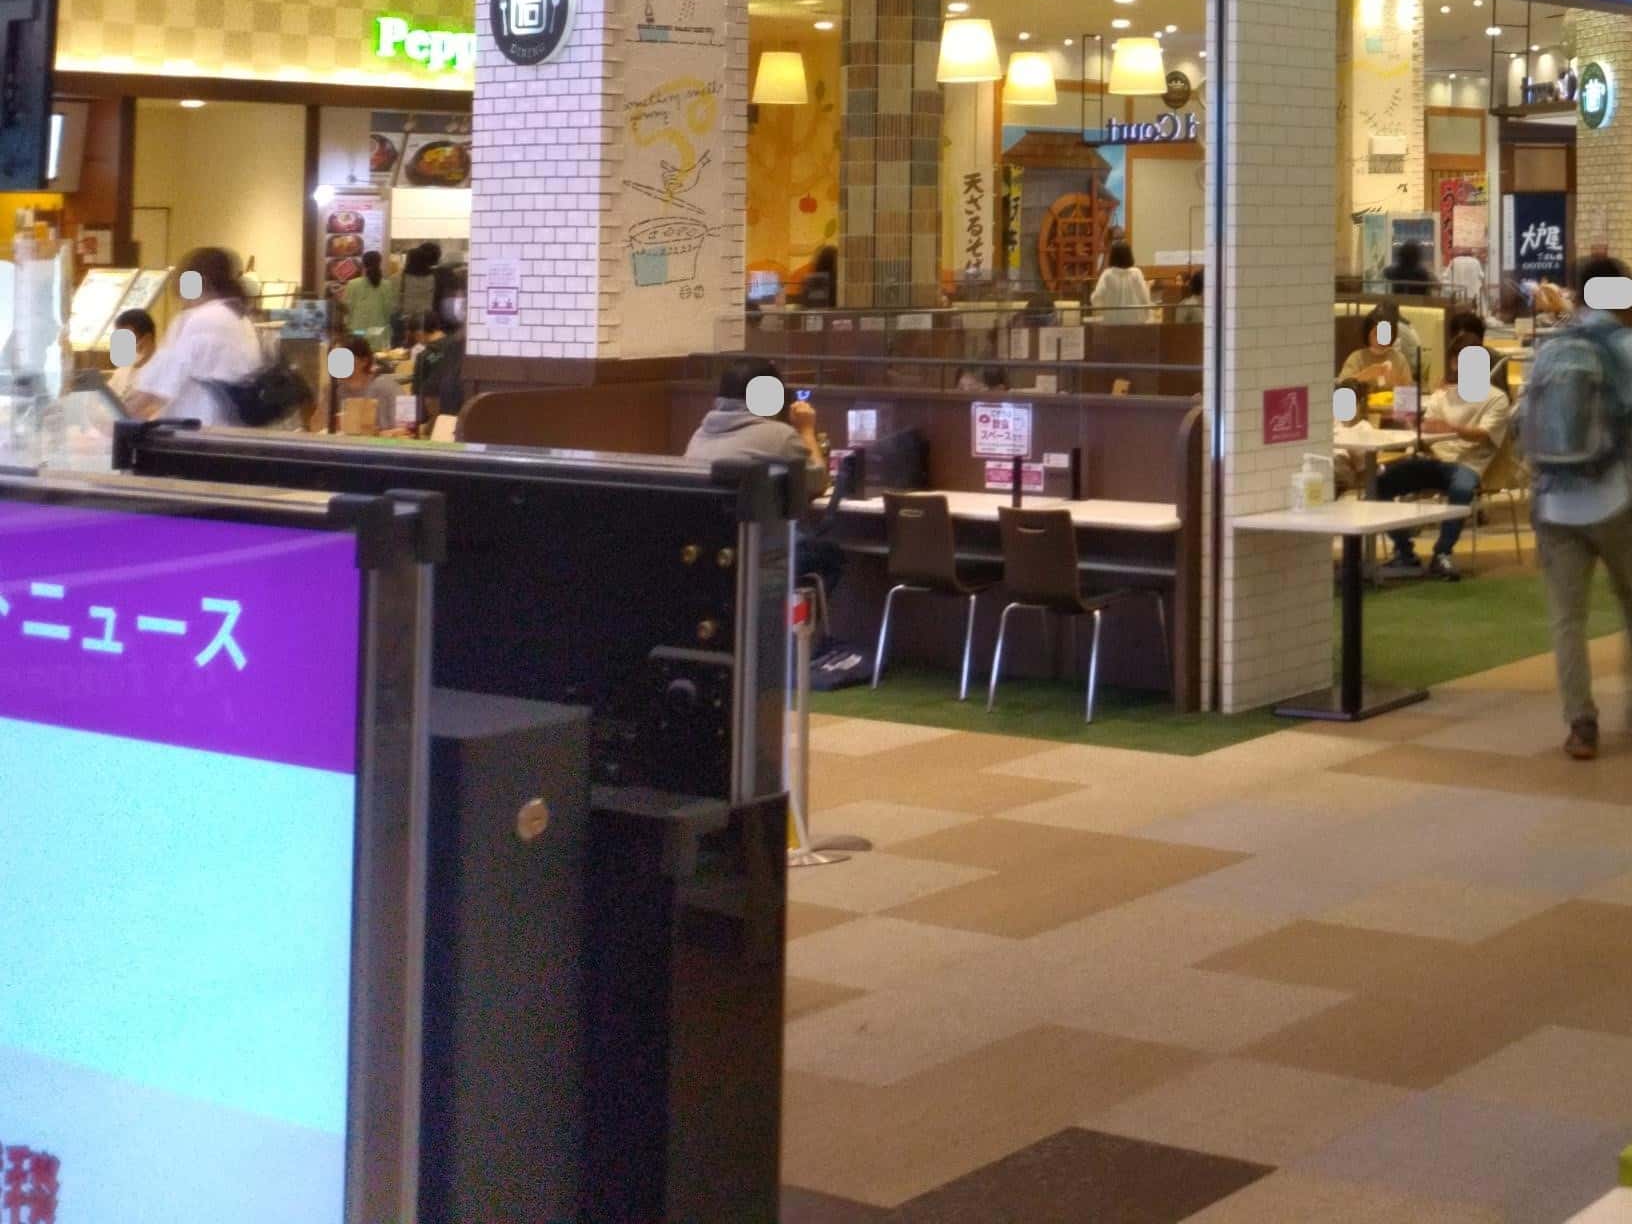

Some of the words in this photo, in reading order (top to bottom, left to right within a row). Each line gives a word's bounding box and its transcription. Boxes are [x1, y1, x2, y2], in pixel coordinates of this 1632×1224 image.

[1519, 221, 1564, 257] 大戸屋
[0, 579, 248, 671] ニュース
